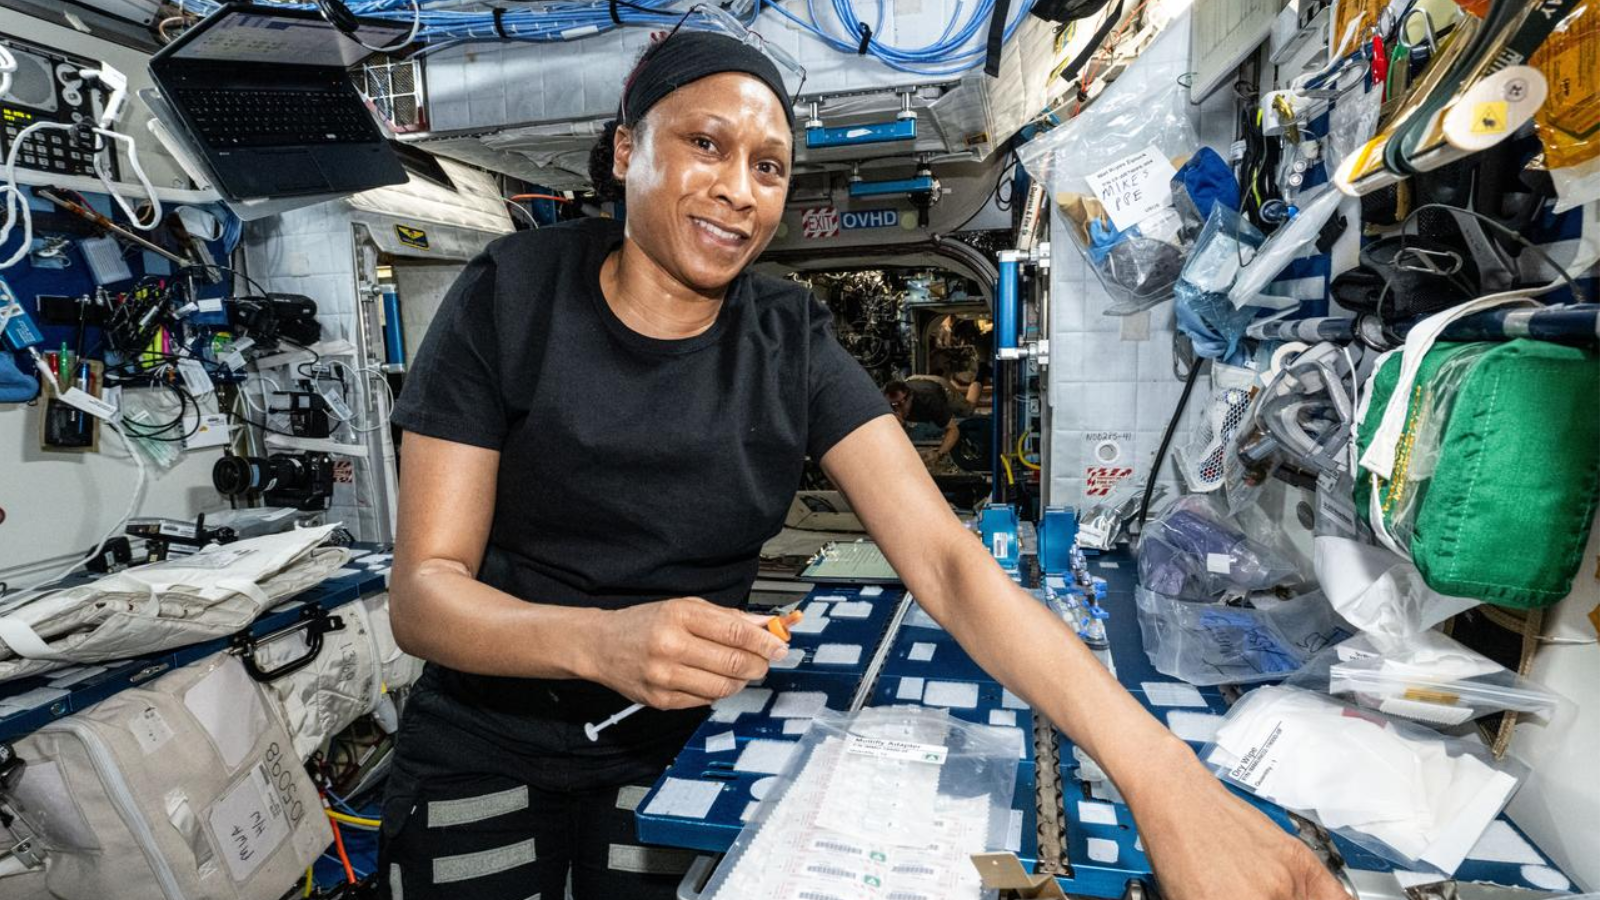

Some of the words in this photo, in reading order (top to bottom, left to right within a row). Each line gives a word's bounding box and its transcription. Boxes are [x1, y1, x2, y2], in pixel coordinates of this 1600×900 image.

[808, 214, 834, 233] EXIT
[842, 210, 897, 228] OVHD
[1231, 764, 1247, 777] Dry
[1240, 747, 1257, 764] Wipe
